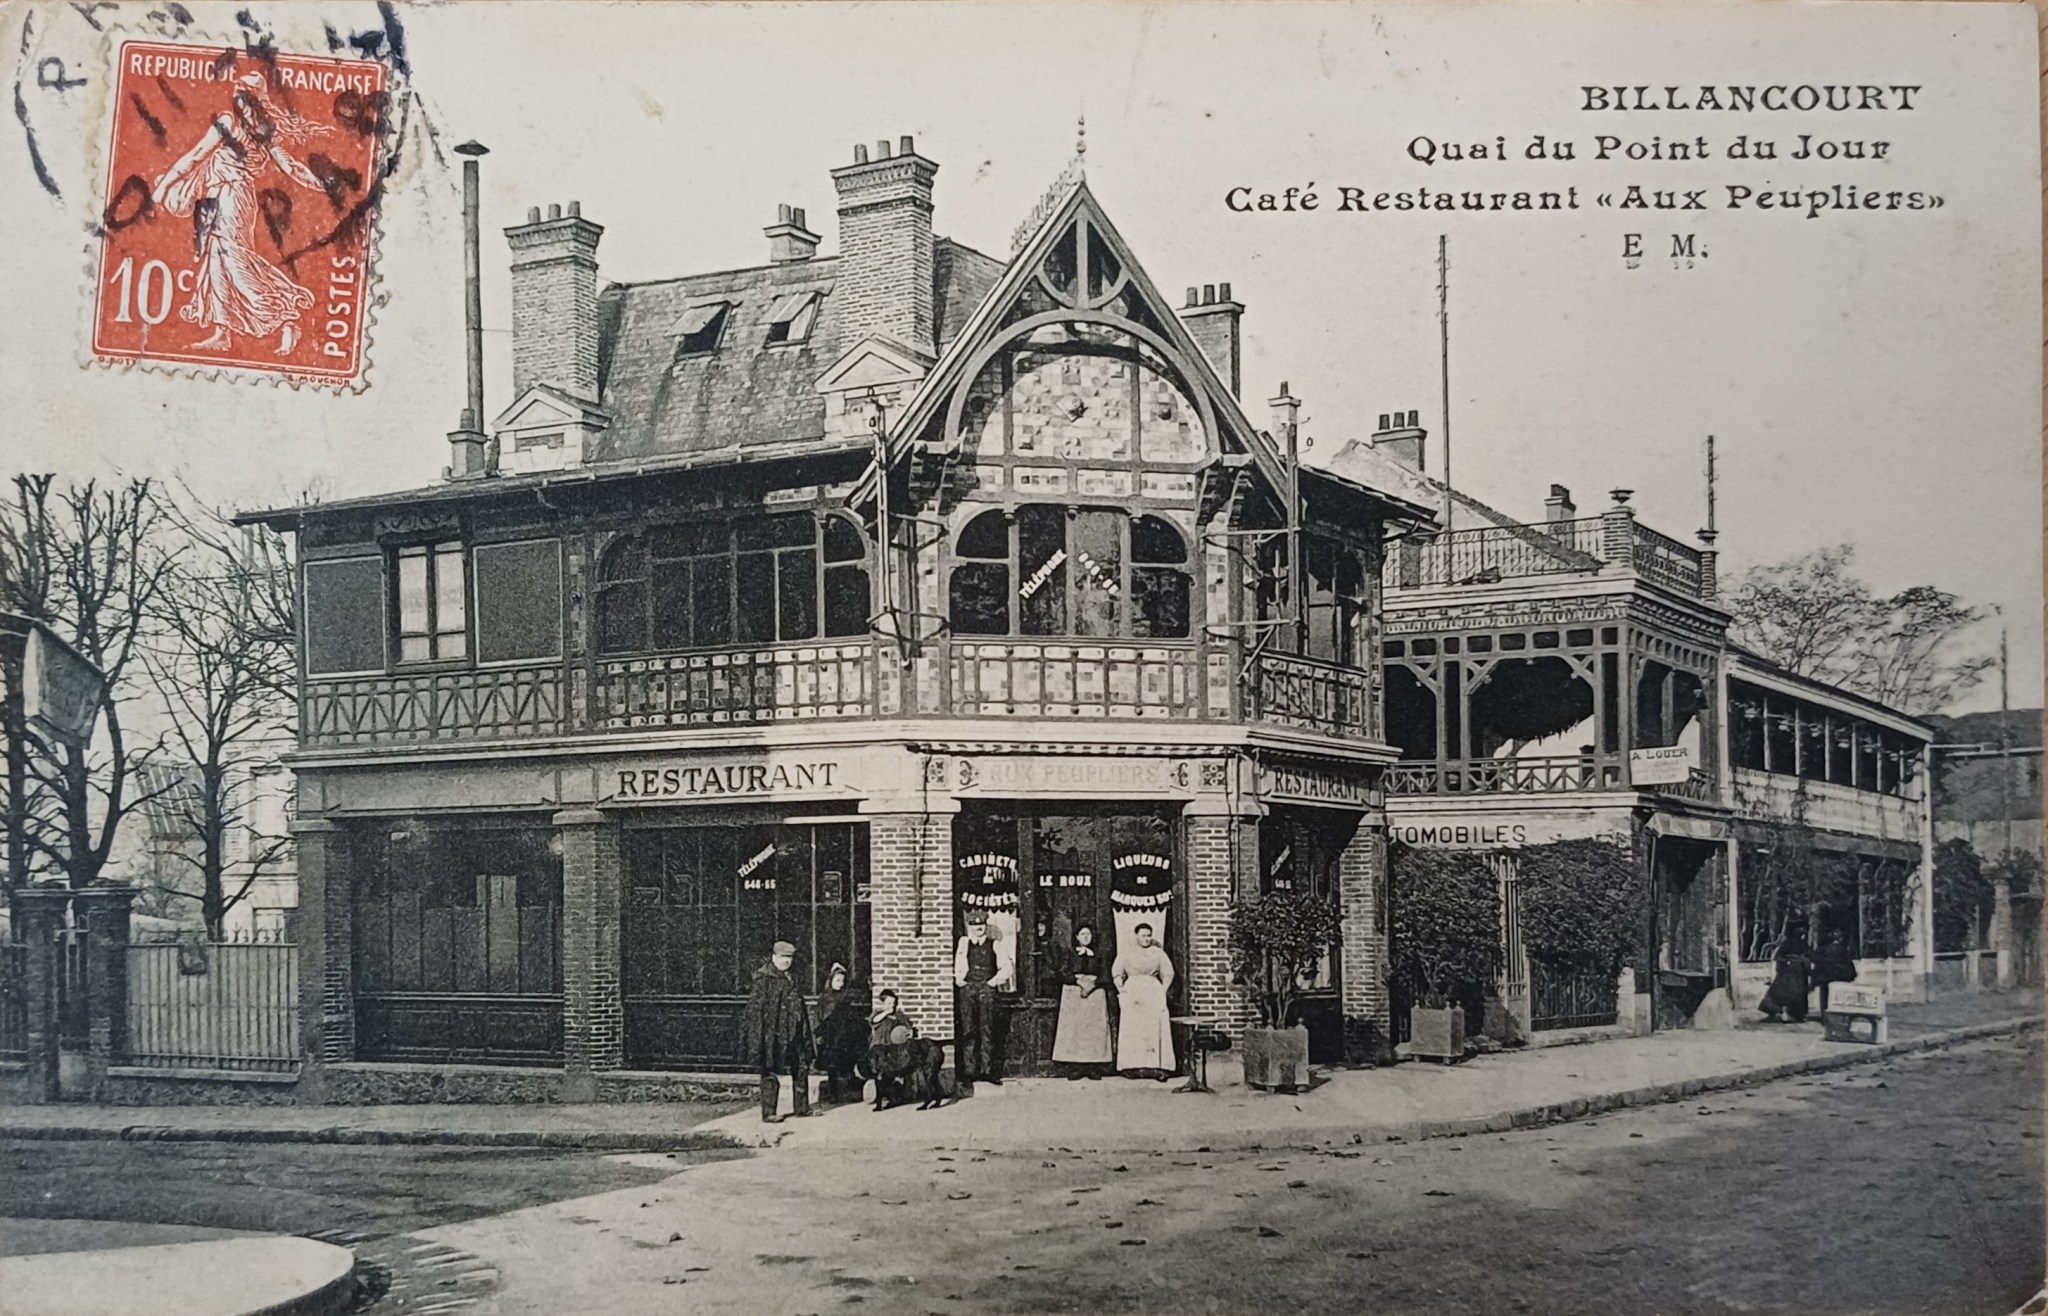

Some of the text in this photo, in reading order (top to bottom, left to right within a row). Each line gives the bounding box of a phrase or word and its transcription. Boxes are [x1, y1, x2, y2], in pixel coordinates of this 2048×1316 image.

[323, 256, 357, 358] POSTES
[1632, 748, 1688, 761] A LOUER
[618, 762, 838, 797] RESTAURANT
[1043, 764, 1160, 785] PEUPLIERS
[1274, 768, 1360, 800] RESTAURANT
[1392, 824, 1527, 844] TOMOBILES
[1113, 854, 1170, 870] LIQUEURS
[1039, 875, 1053, 887] LE
